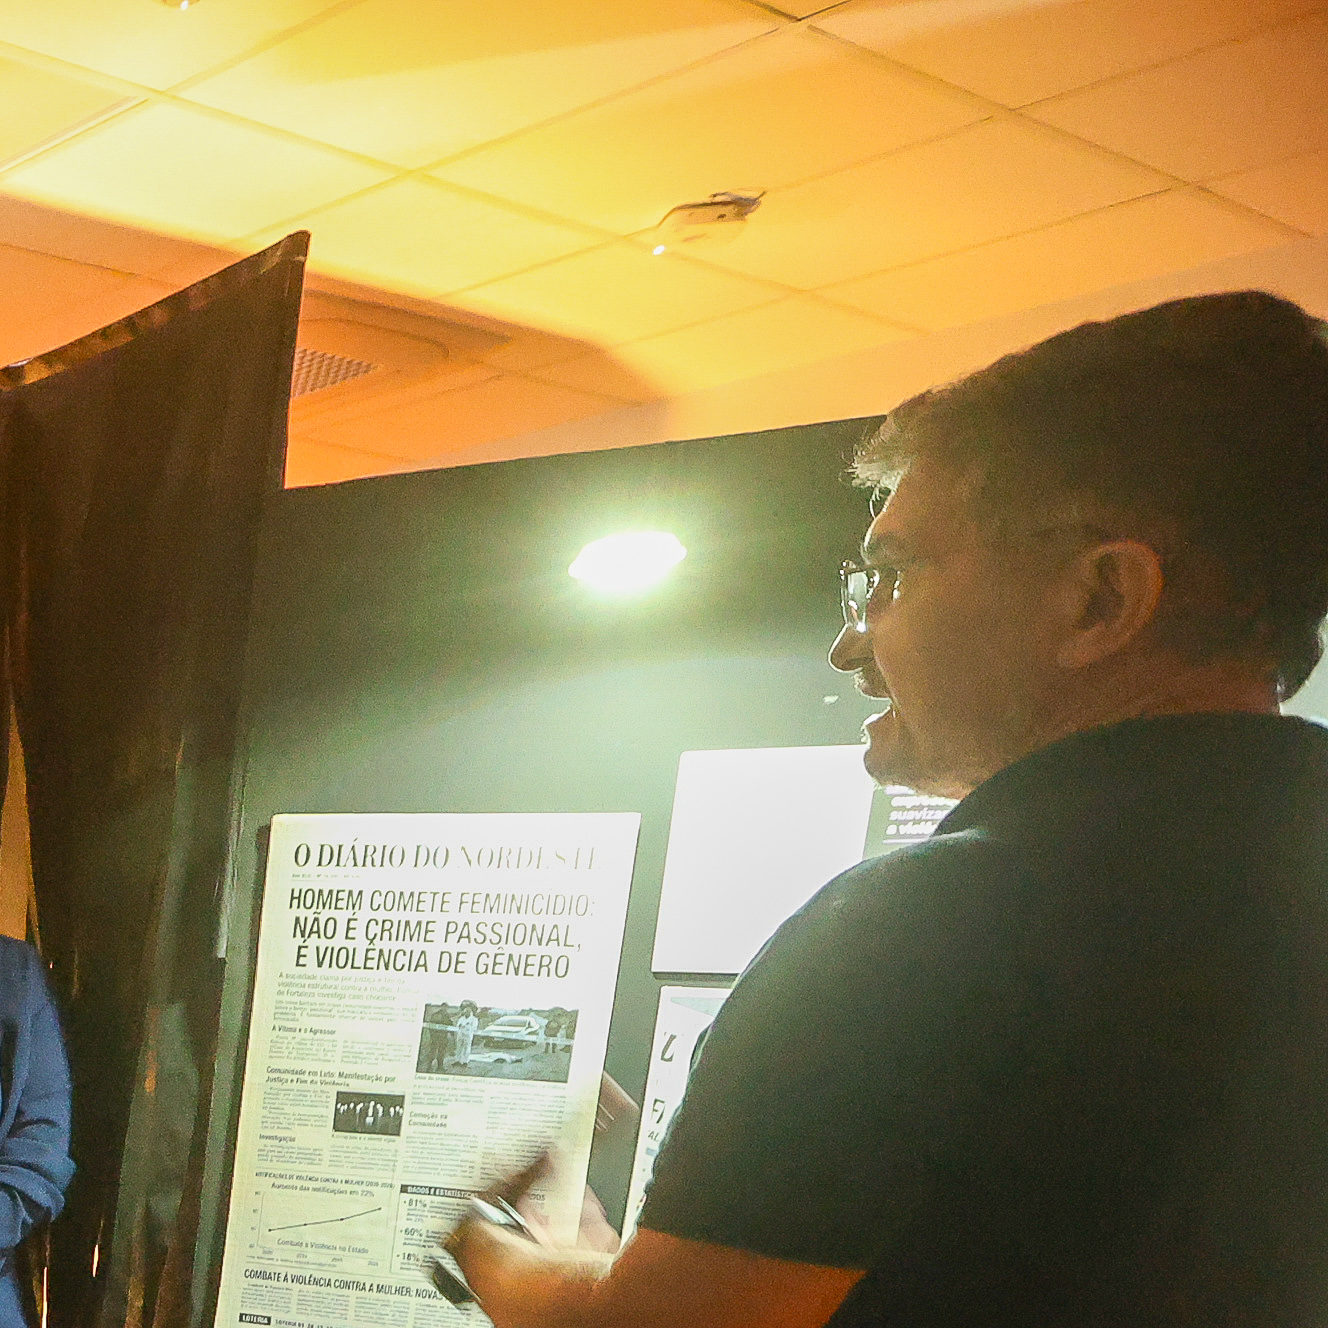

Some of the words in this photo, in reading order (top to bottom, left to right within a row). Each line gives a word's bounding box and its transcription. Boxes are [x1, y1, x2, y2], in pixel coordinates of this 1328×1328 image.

[294, 843, 311, 867] O
[316, 837, 406, 868] DIÁRIO
[413, 844, 450, 869] DO
[289, 887, 363, 911] HOMEM
[369, 890, 452, 913] COMETE
[293, 911, 337, 940] NÃO
[345, 912, 358, 941] É
[365, 918, 437, 943] CRIME
[444, 920, 581, 952] PASSIONAL,
[295, 938, 309, 968] É
[315, 940, 429, 973] VIOLÊNCIA
[437, 950, 467, 974] DE
[475, 946, 570, 979] GÊNERO
[266, 1066, 306, 1077] Comunidade
[244, 1268, 282, 1283] COMBATE
[290, 1273, 332, 1289] VIOLÊNCIA
[333, 1278, 367, 1293] CONTRA
[368, 1283, 374, 1293] A
[375, 1283, 413, 1297] MULHER:
